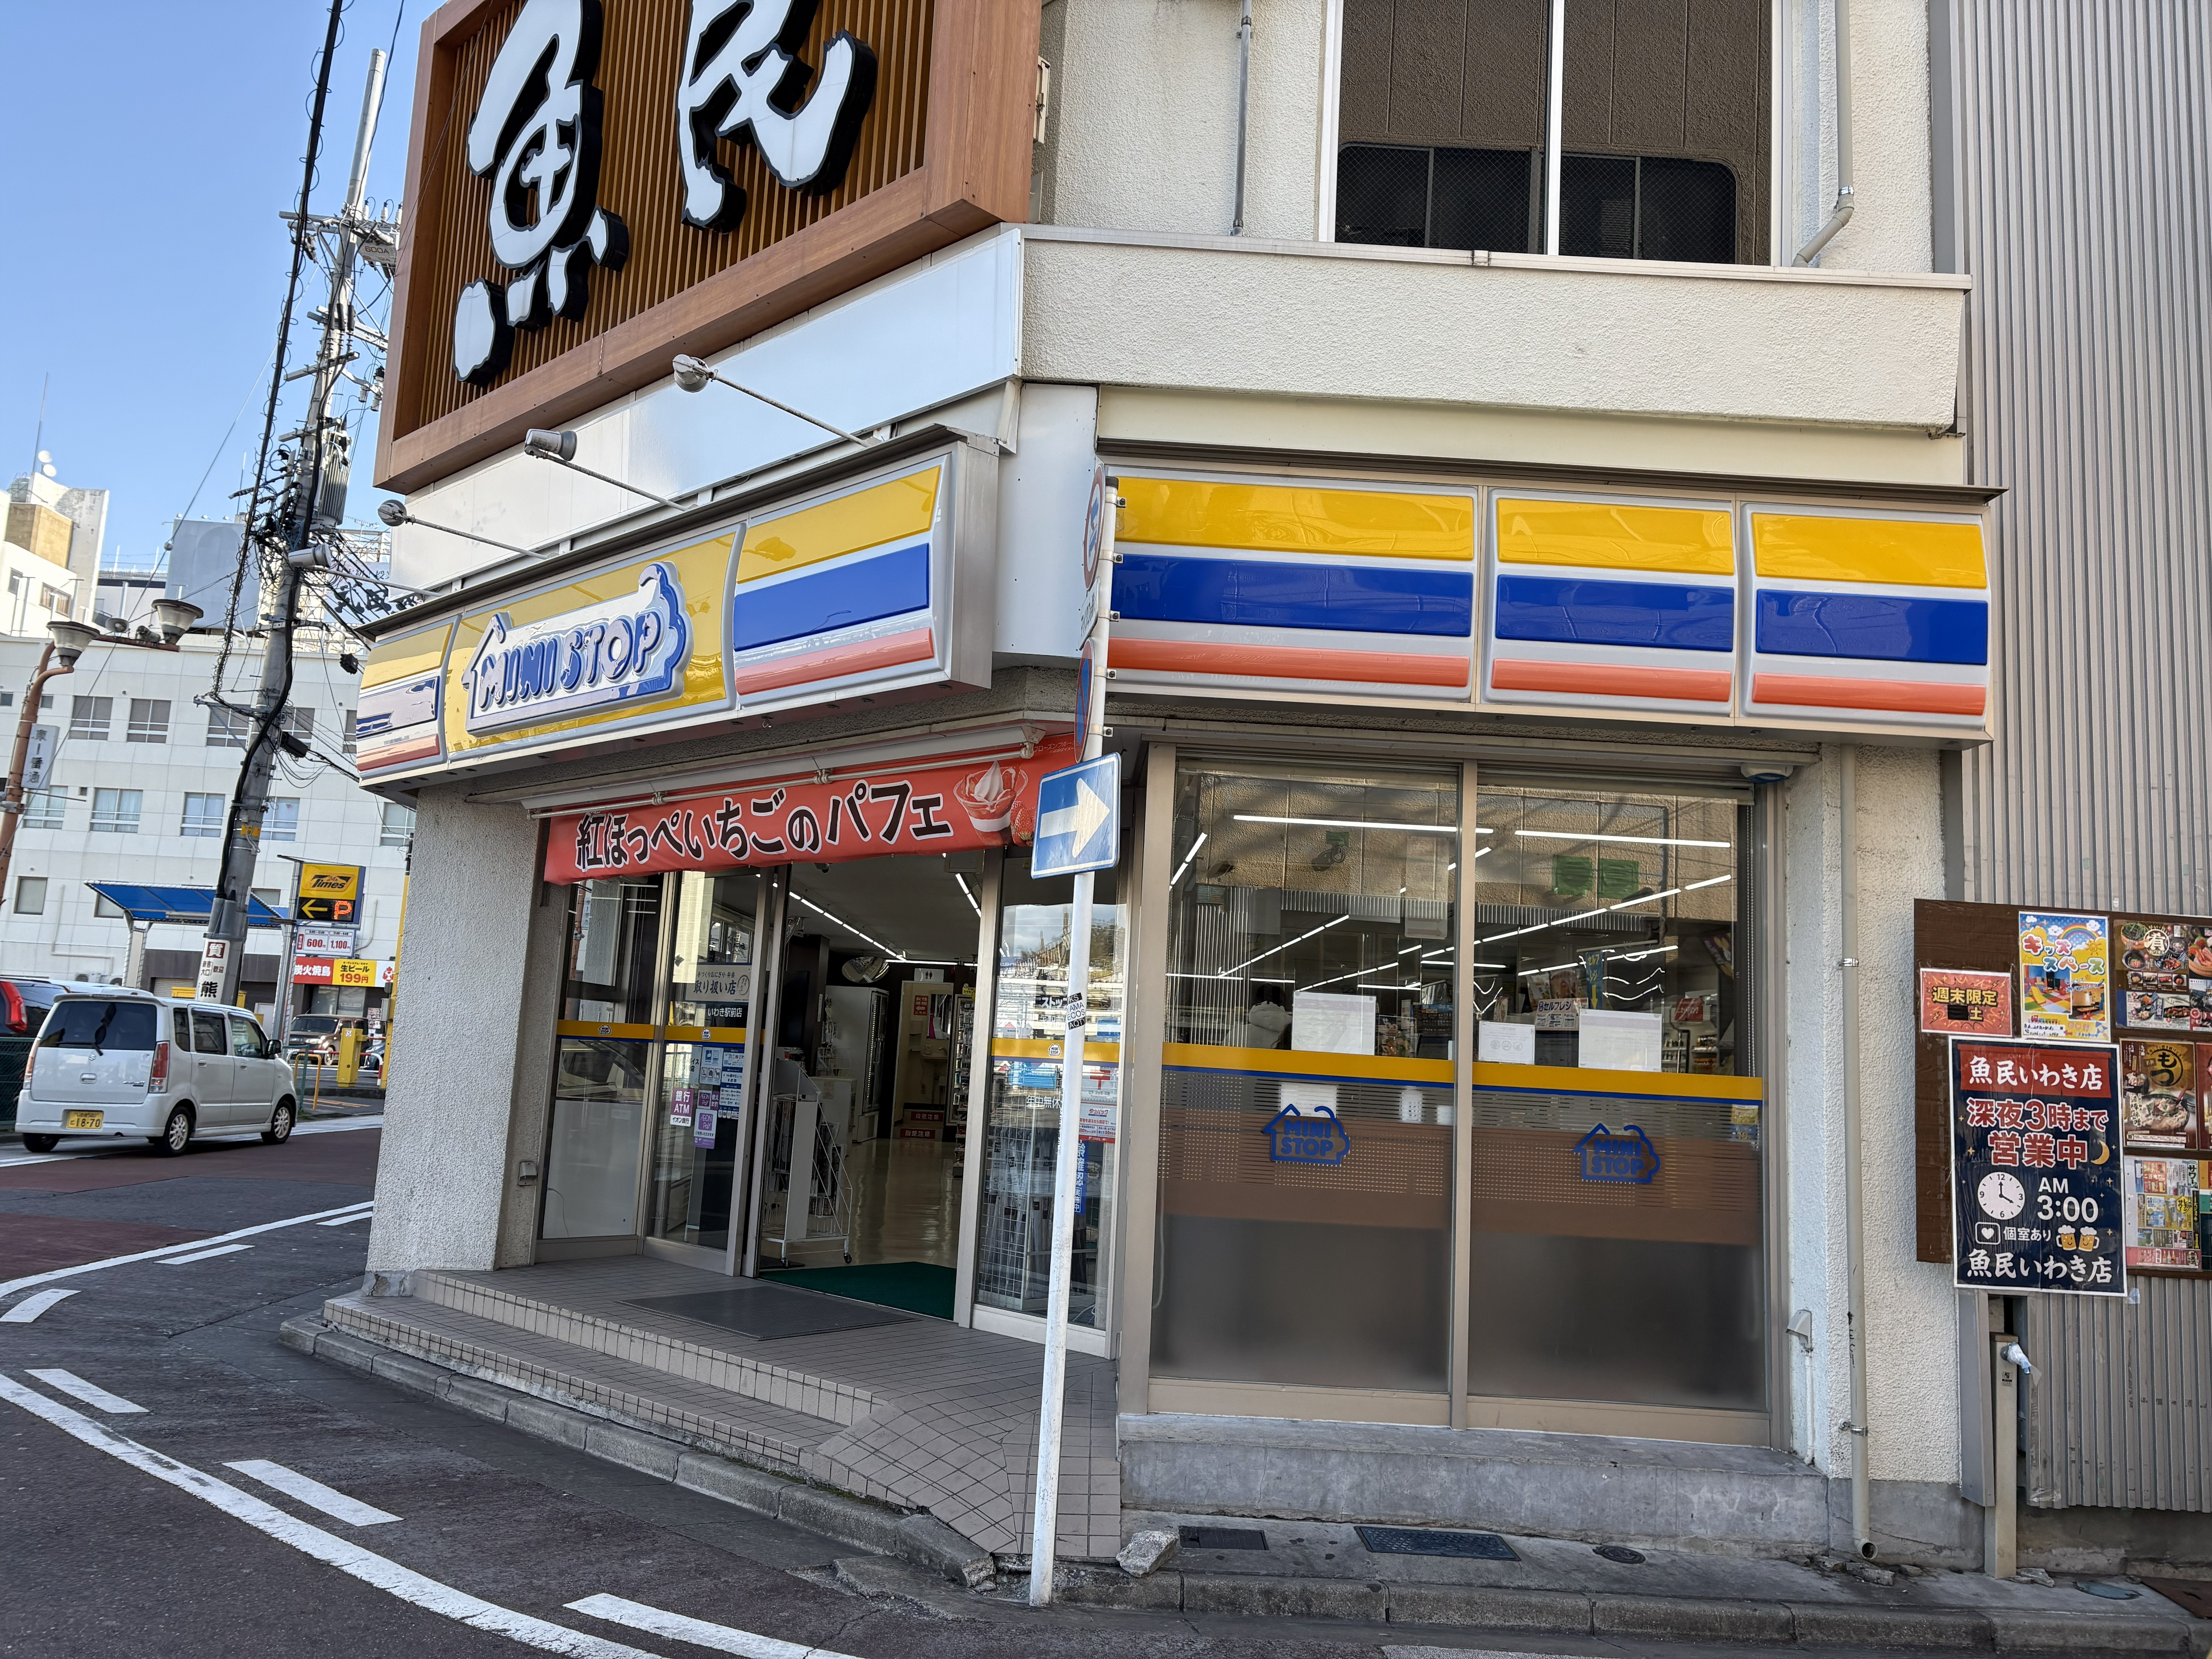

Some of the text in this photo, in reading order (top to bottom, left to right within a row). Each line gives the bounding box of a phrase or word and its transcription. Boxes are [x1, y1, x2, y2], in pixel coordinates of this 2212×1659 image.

[364, 246, 389, 254] 600A
[1034, 741, 1074, 752] フローズンフルー
[575, 780, 953, 872] 紅ほっぺいちごのパフェ
[312, 878, 346, 889] Times
[333, 900, 352, 920] P
[208, 943, 223, 957] 質
[2022, 934, 2072, 955] キッズ
[294, 965, 331, 977] 炭火焼鳥
[340, 964, 370, 973] 生ビール
[2042, 956, 2105, 975] スペース
[340, 973, 369, 983] 199円
[693, 979, 737, 995] 取り扱い店
[200, 981, 218, 998] 熊
[1932, 986, 1998, 1007] 週末限定
[708, 1007, 743, 1018] いわき駅前店
[1969, 1055, 2102, 1091] 魚民いわき店
[2150, 1052, 2177, 1085] もつ
[675, 1090, 690, 1103] 銀行
[1026, 1095, 1061, 1109] 年中無休
[674, 1104, 690, 1114] ATM
[1966, 1097, 2109, 1132] 深夜3時まで
[1284, 1118, 1332, 1139] MINI
[1280, 1137, 1334, 1158] STOP
[1593, 1138, 1642, 1157] MINI
[1987, 1130, 2088, 1170] 営業中
[1591, 1157, 1644, 1176] STOP
[2188, 1165, 2197, 1185] サワー
[2039, 1177, 2069, 1194] AM
[2037, 1195, 2099, 1223] 3:00
[2003, 1226, 2052, 1242] 個室あり
[1967, 1248, 2111, 1284] 魚民いわき店
